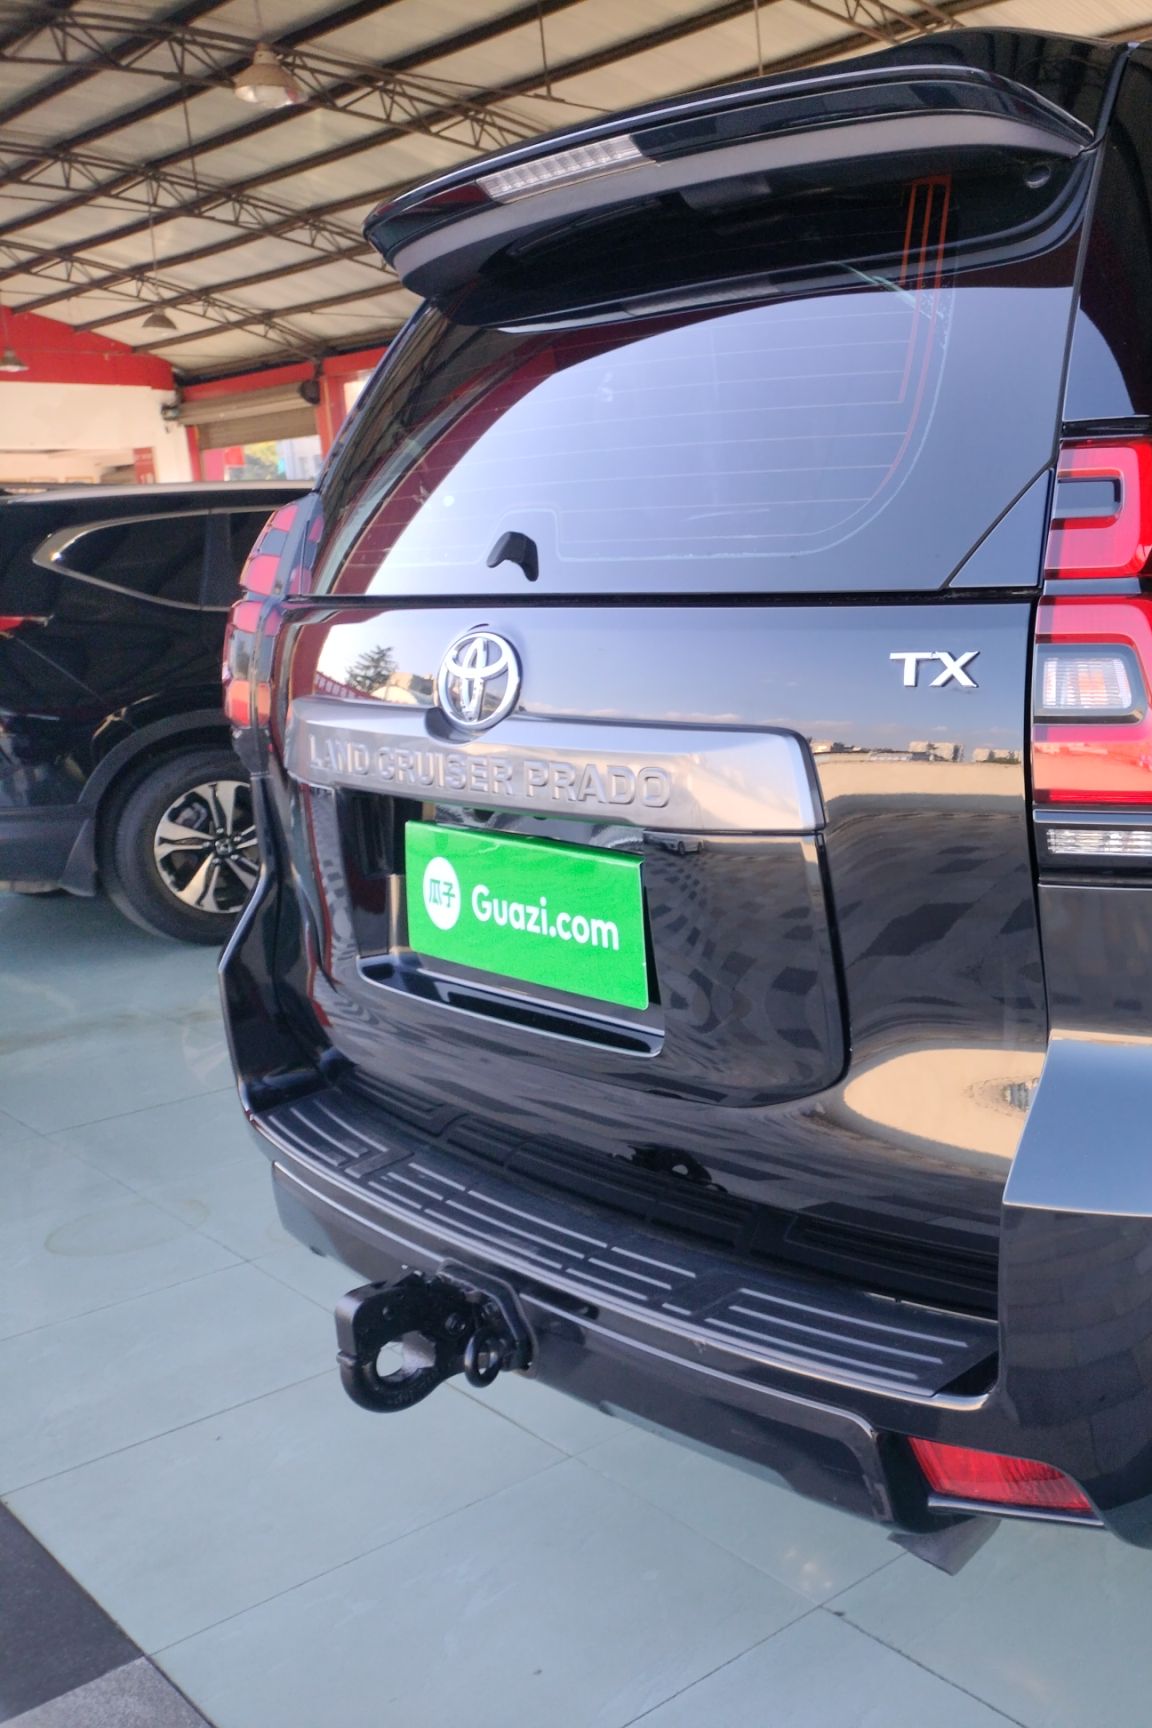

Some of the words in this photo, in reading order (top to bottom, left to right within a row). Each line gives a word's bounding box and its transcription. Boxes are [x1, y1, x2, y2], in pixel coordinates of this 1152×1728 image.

[889, 650, 981, 688] TX
[308, 734, 370, 776] LAND
[377, 746, 515, 796] CRUISER
[523, 759, 673, 809] PRADO
[428, 877, 456, 909] 瓜子
[471, 883, 620, 951] Guazi.com
